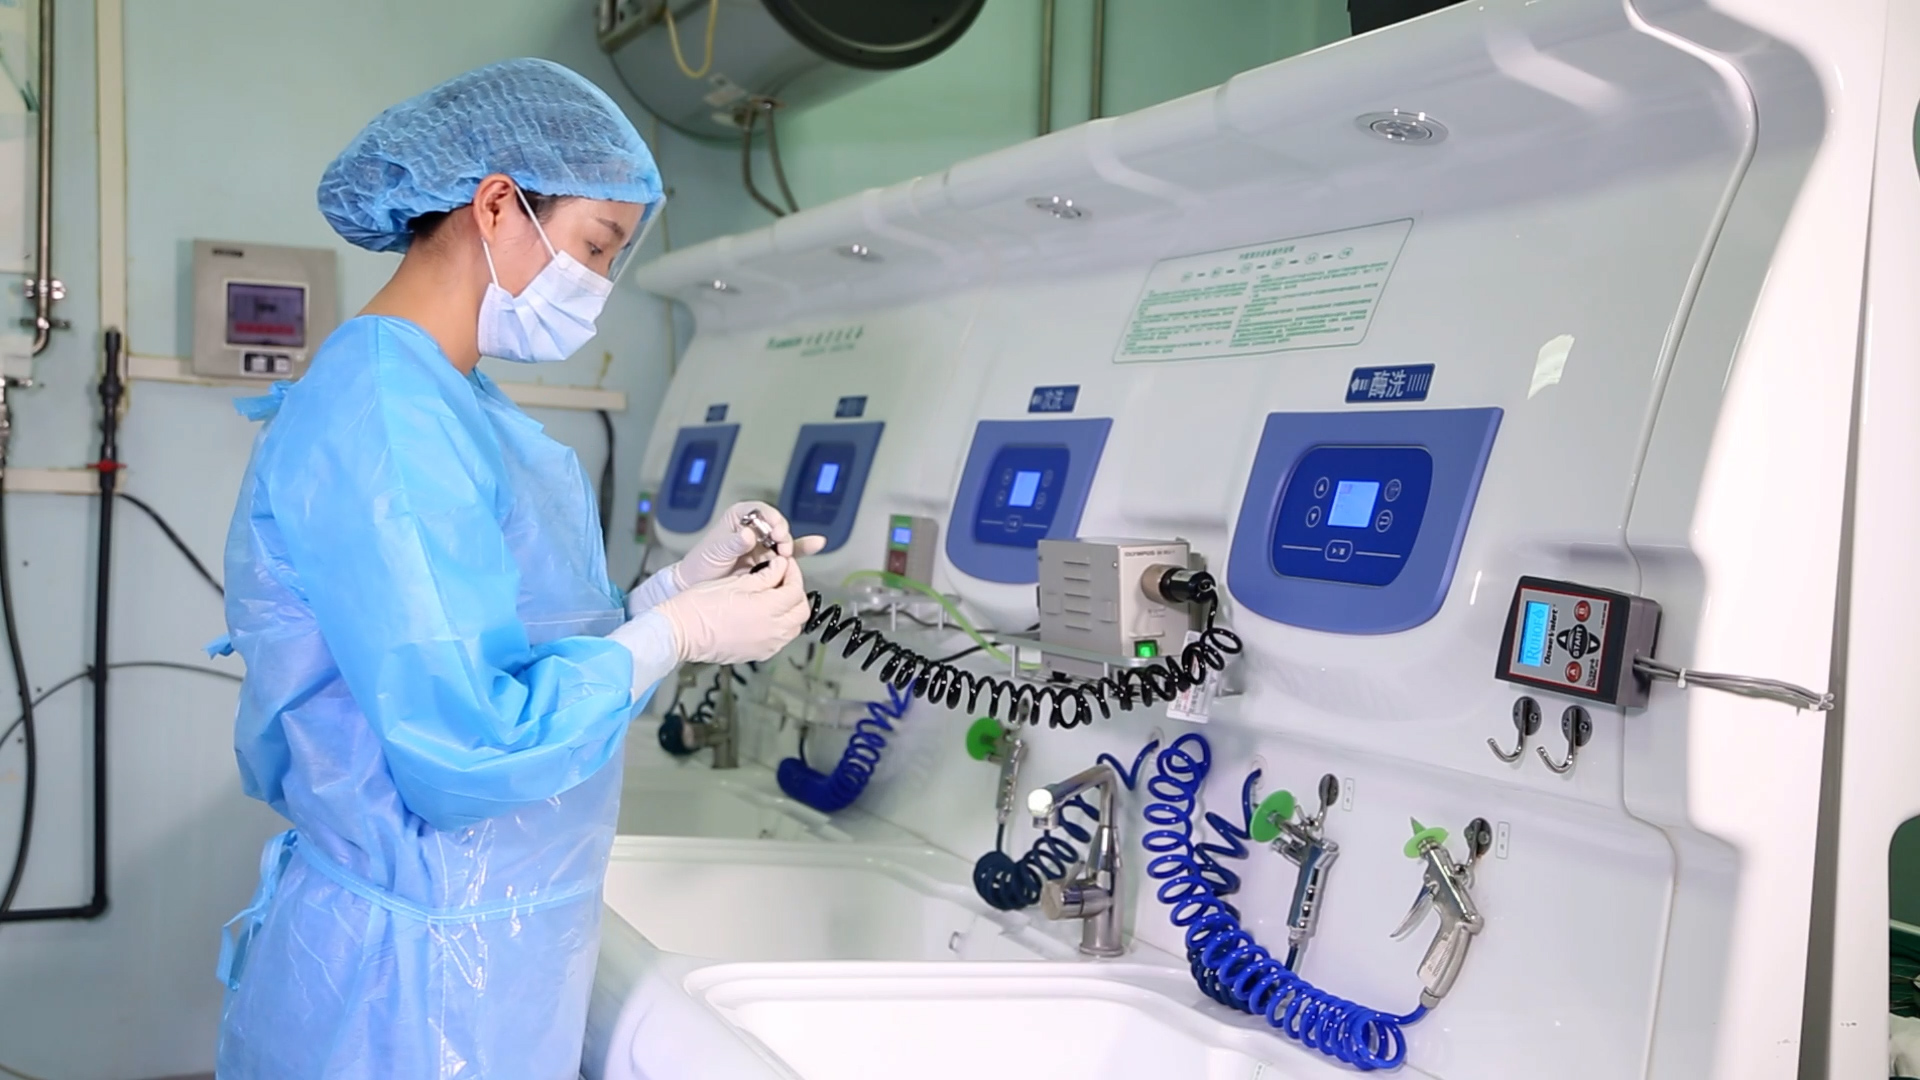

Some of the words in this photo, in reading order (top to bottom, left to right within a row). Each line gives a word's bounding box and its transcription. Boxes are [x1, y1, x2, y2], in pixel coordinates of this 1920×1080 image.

[1368, 369, 1406, 398] 酶洗
[1545, 609, 1558, 664] DoseValet
[1572, 626, 1584, 657] START
[1569, 668, 1577, 676] A
